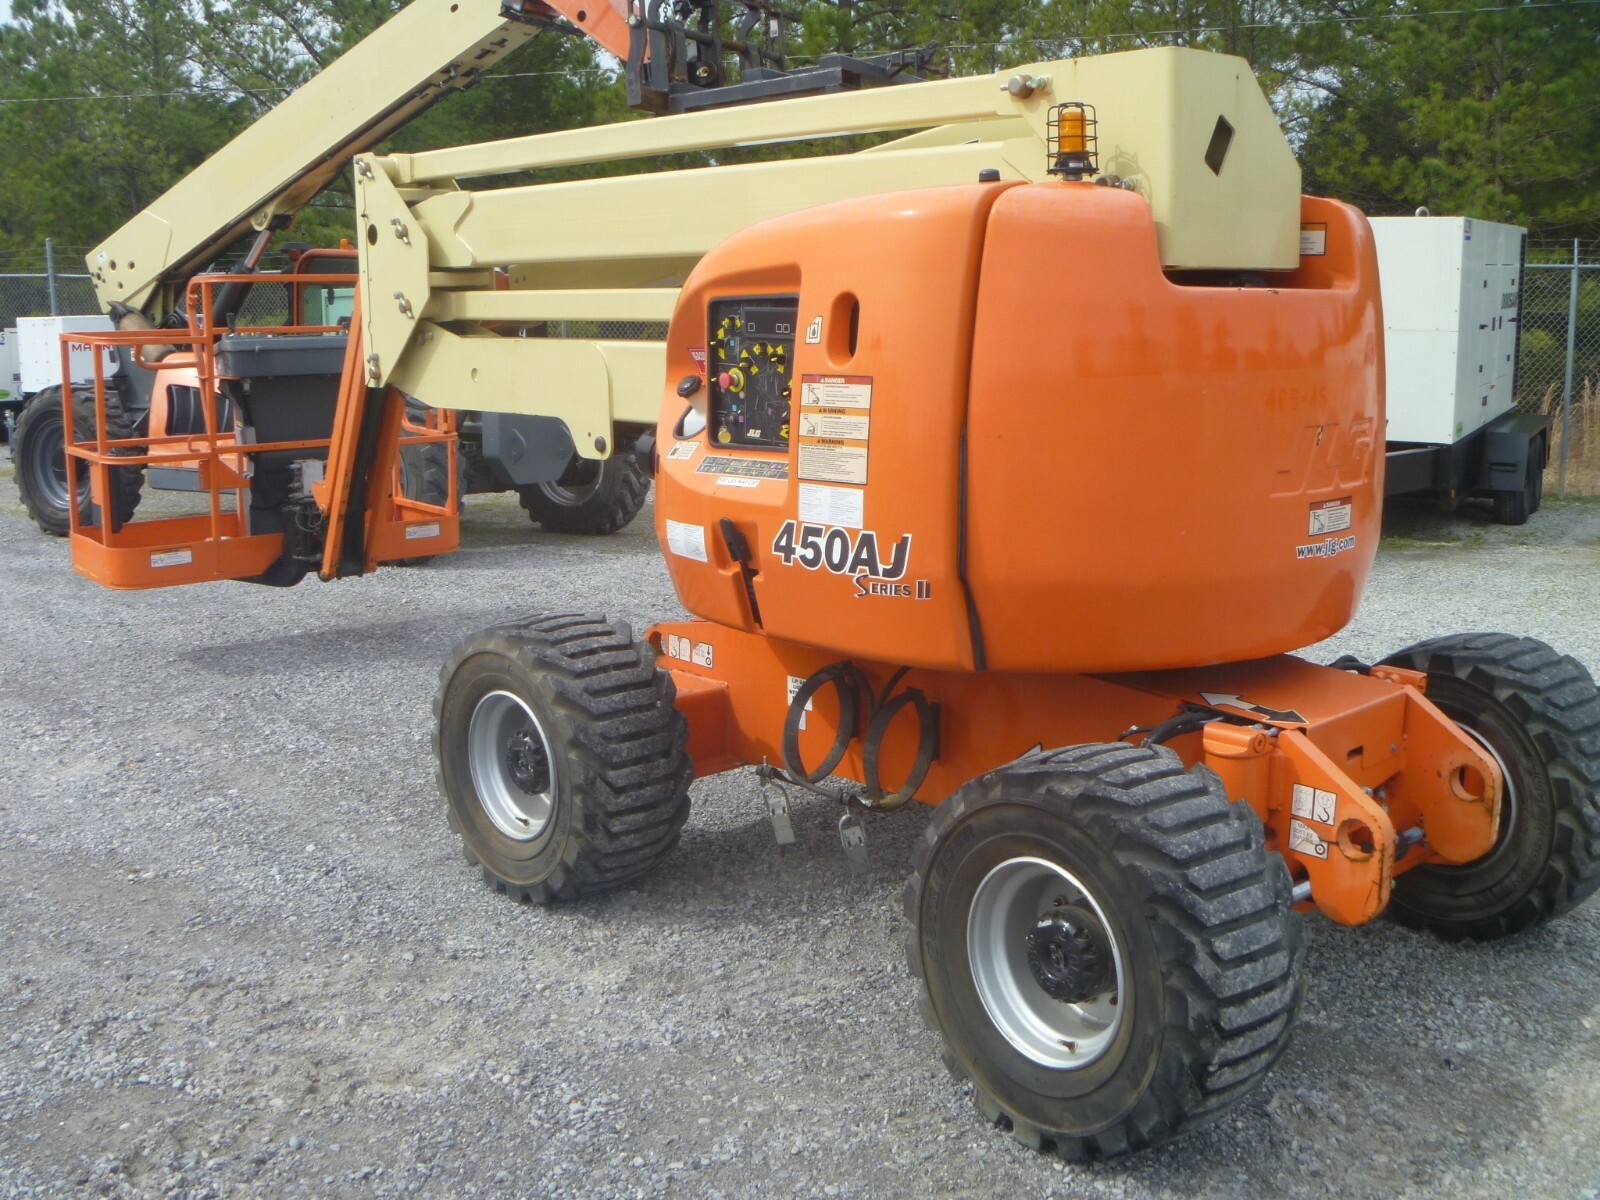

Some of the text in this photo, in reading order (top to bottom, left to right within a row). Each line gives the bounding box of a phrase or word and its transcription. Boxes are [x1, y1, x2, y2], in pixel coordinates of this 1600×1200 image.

[821, 438, 845, 446] WARNING
[1270, 416, 1375, 498] JLG
[772, 519, 912, 581] 450AJ
[1296, 535, 1355, 559] www.jlg.com
